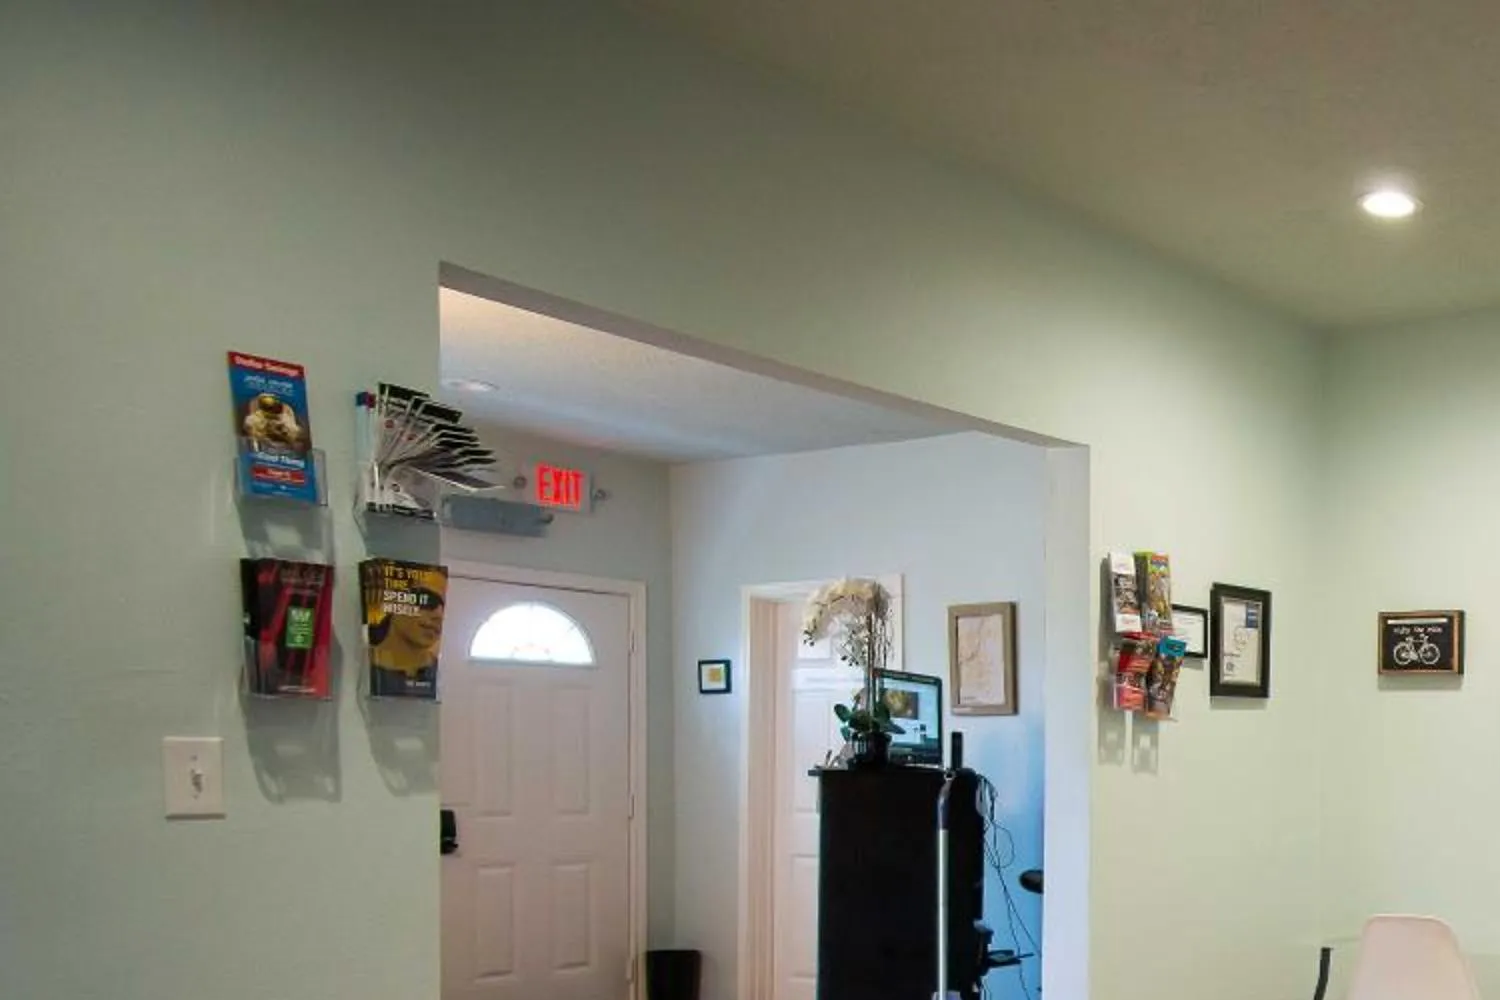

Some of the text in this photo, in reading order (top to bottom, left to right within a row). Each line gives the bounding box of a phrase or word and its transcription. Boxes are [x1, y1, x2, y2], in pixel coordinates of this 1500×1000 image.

[536, 464, 584, 511] EXIT
[384, 591, 429, 605] SPEND IT
